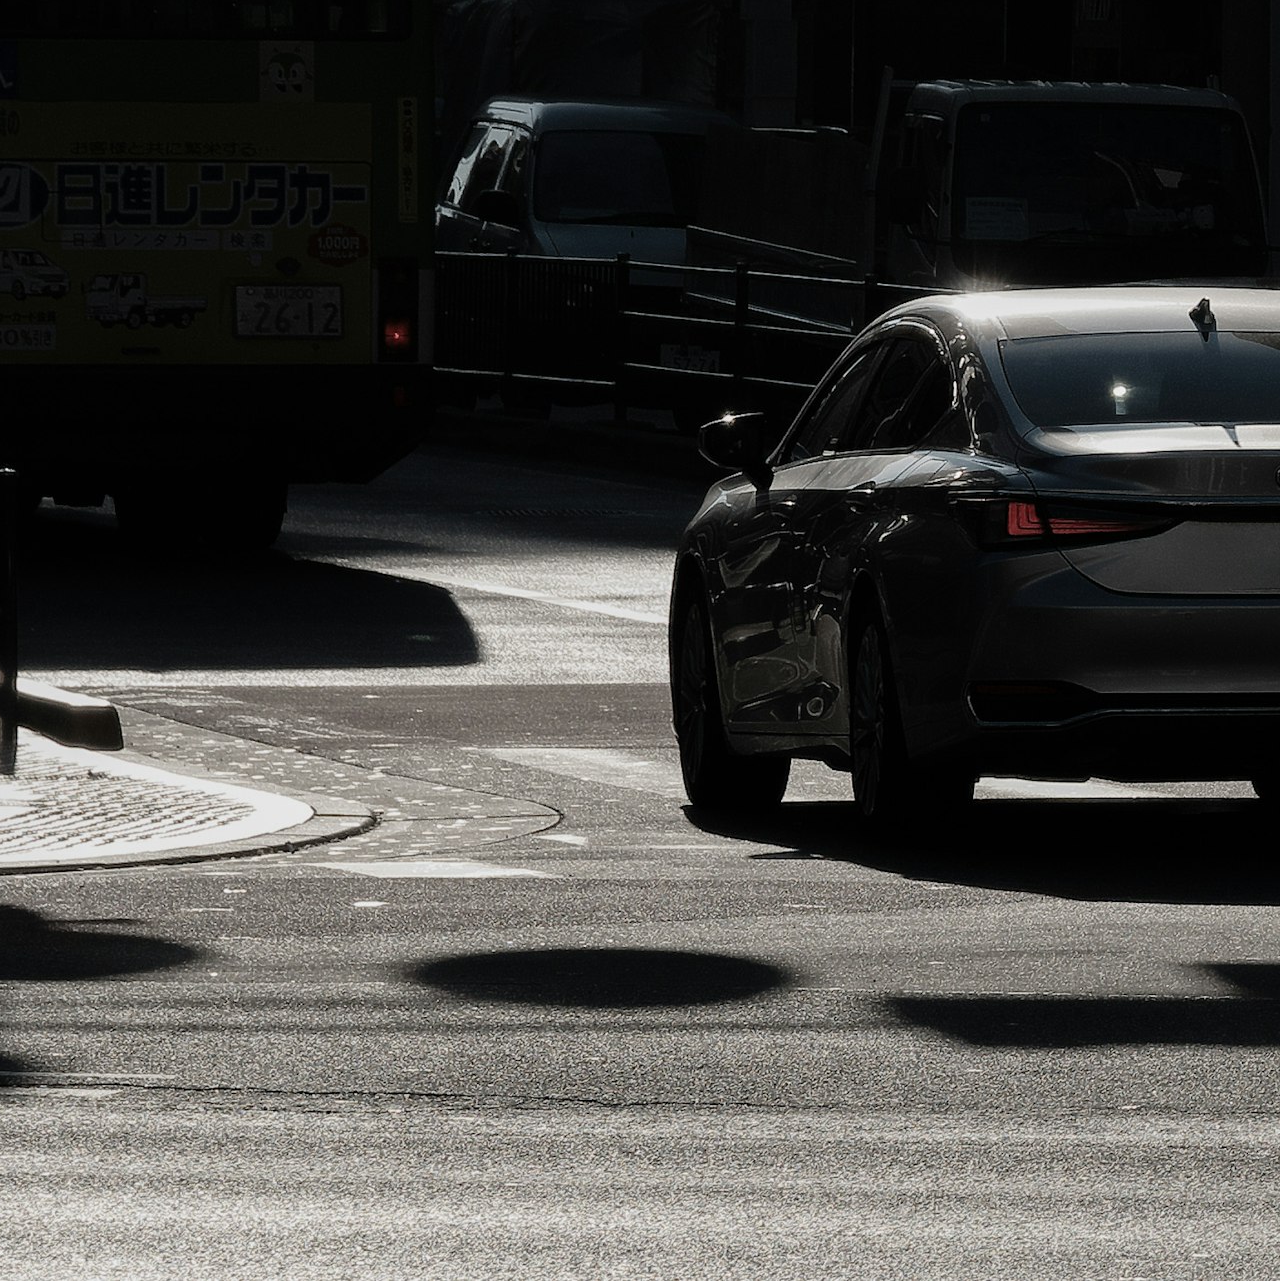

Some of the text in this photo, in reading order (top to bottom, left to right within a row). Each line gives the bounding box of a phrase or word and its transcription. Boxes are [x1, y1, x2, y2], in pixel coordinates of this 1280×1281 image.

[57, 163, 367, 226] 日進レンタカー
[71, 232, 266, 248] 日進レンタカー 検索
[254, 301, 339, 334] 26-12
